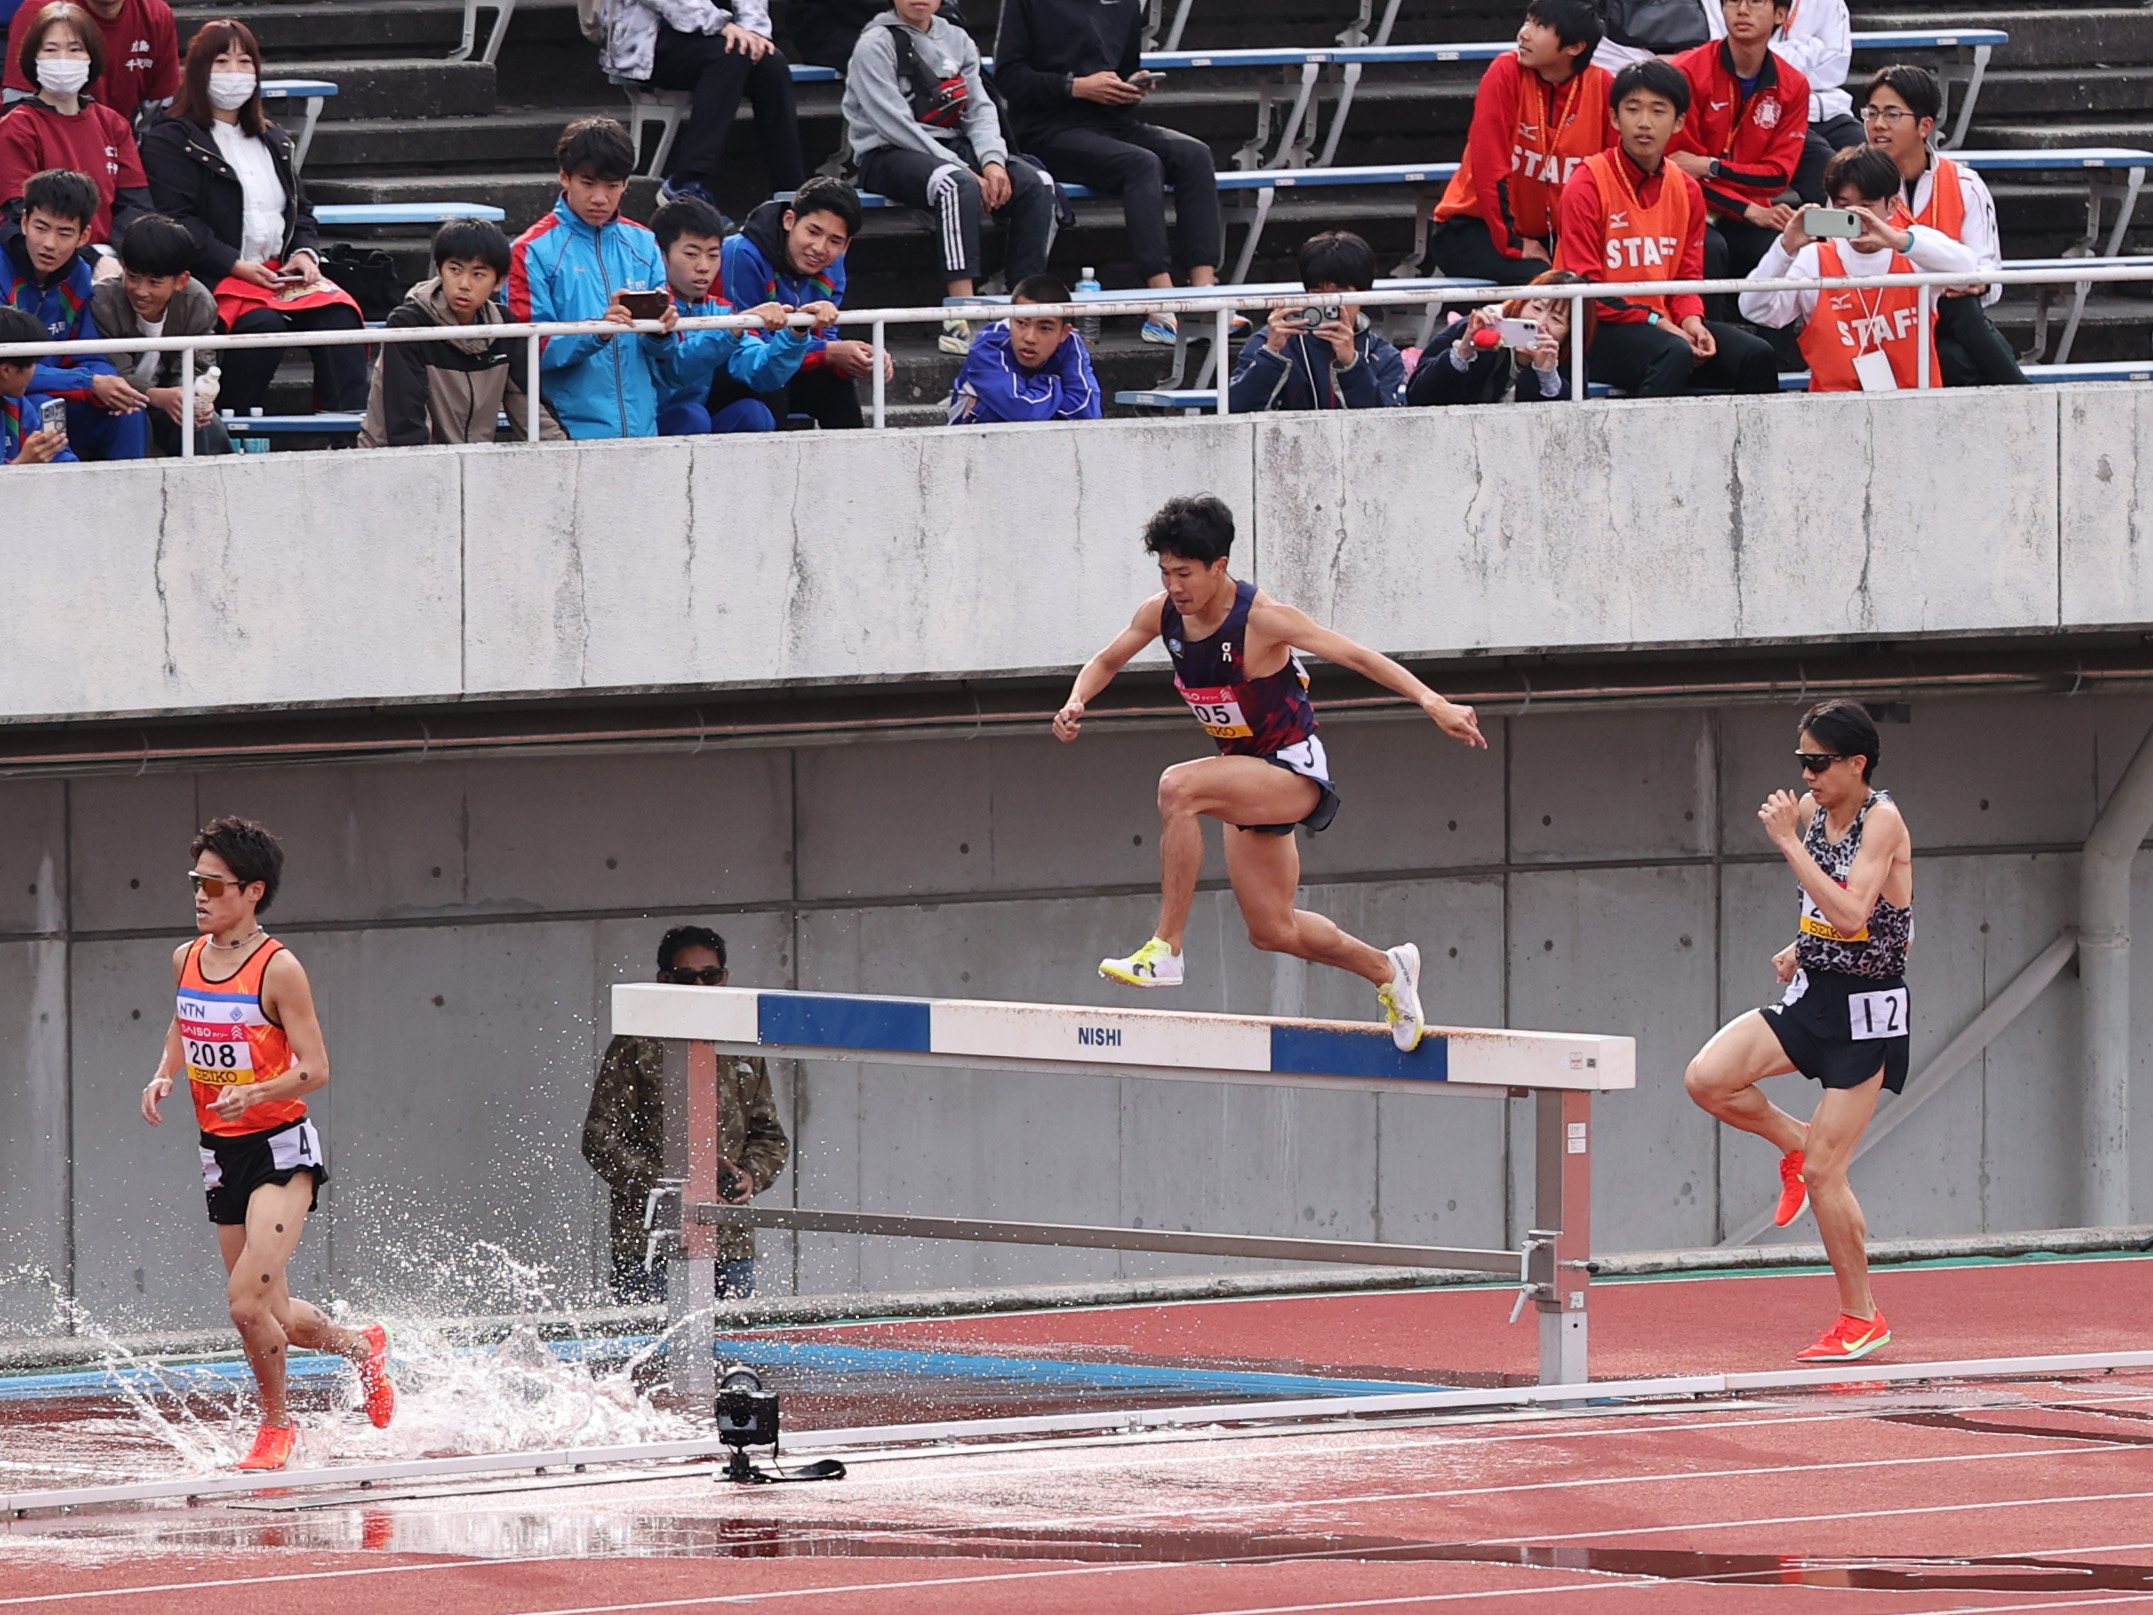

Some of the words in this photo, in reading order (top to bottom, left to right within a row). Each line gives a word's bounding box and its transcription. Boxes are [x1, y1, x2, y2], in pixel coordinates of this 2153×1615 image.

[1511, 144, 1583, 184] STAF
[1809, 921, 1842, 939] SEIK
[179, 1002, 205, 1019] NTN
[1863, 995, 1899, 1034] 12
[1078, 1026, 1122, 1047] NISHI
[189, 1041, 237, 1068] 208
[194, 1068, 238, 1083] SEIKO
[298, 1125, 312, 1161] 4
